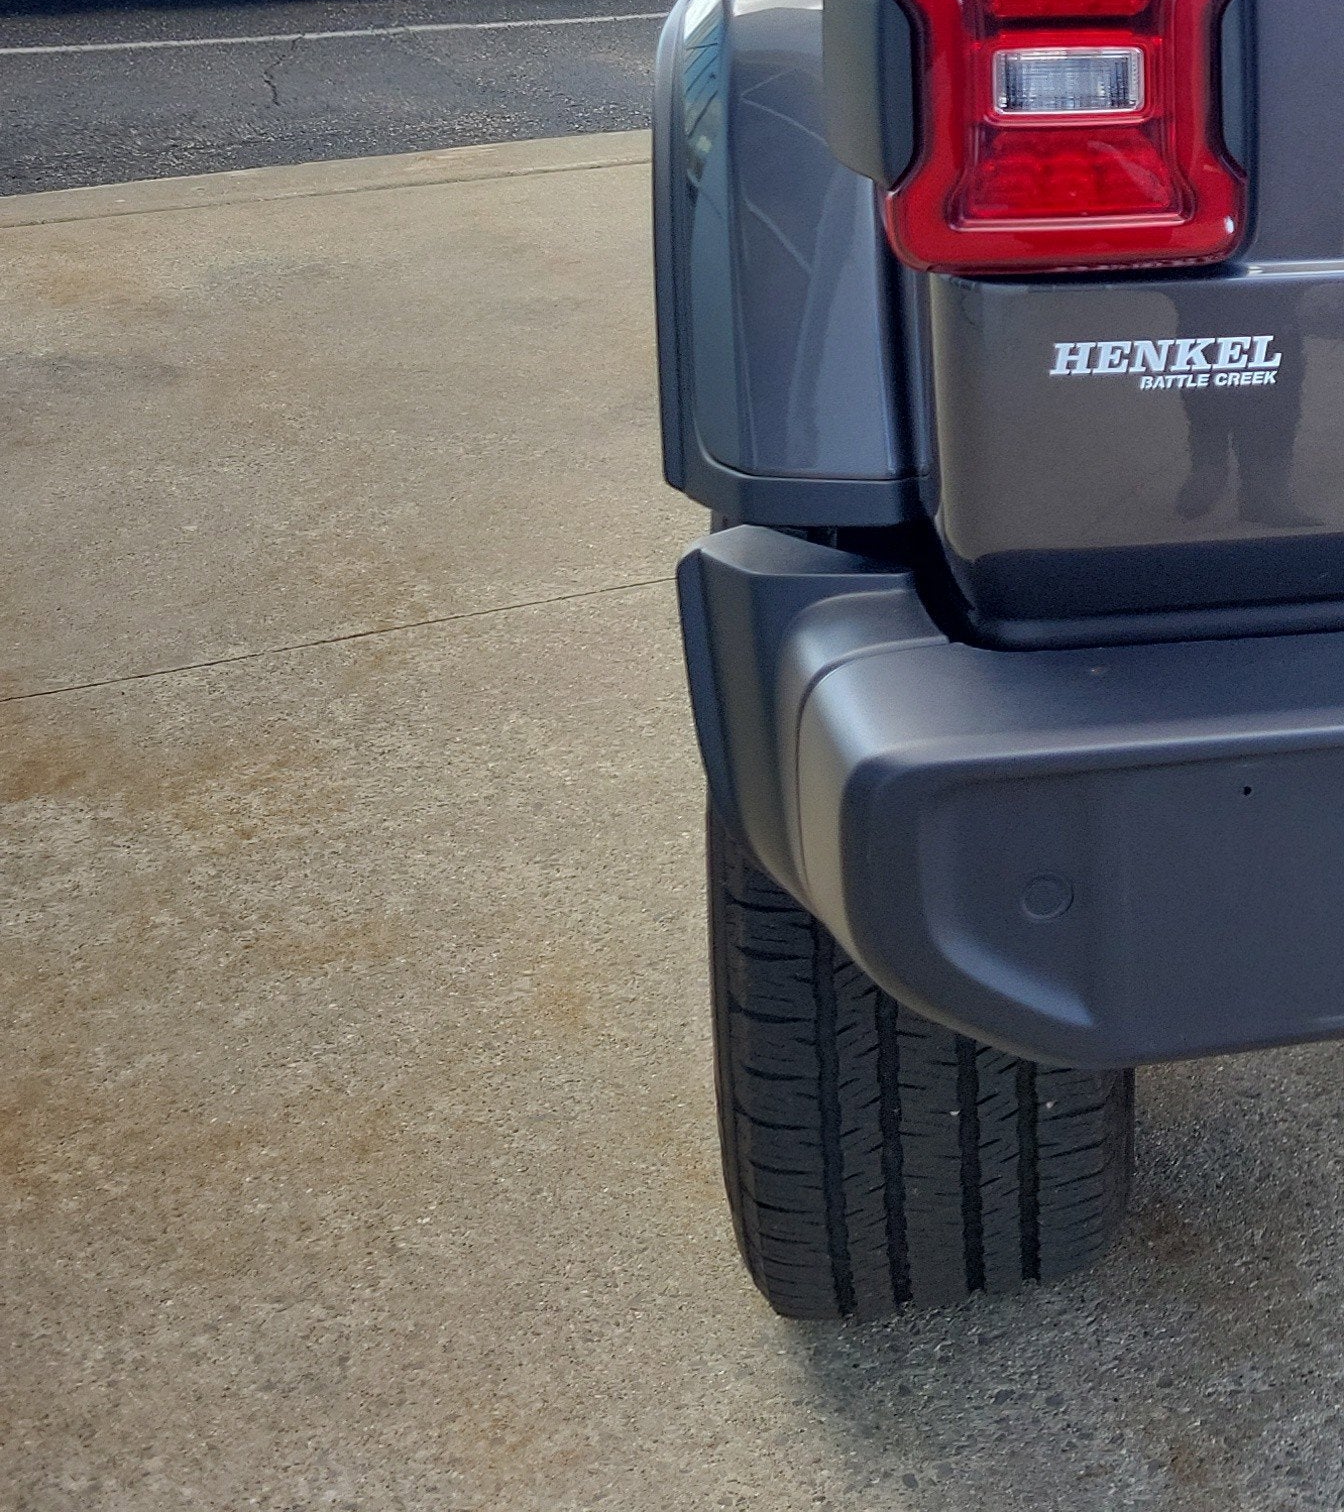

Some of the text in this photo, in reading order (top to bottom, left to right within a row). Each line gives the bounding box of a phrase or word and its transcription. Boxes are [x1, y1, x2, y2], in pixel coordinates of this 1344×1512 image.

[1050, 335, 1282, 376] HENKEL
[1140, 370, 1278, 390] BATTLE CREEK
